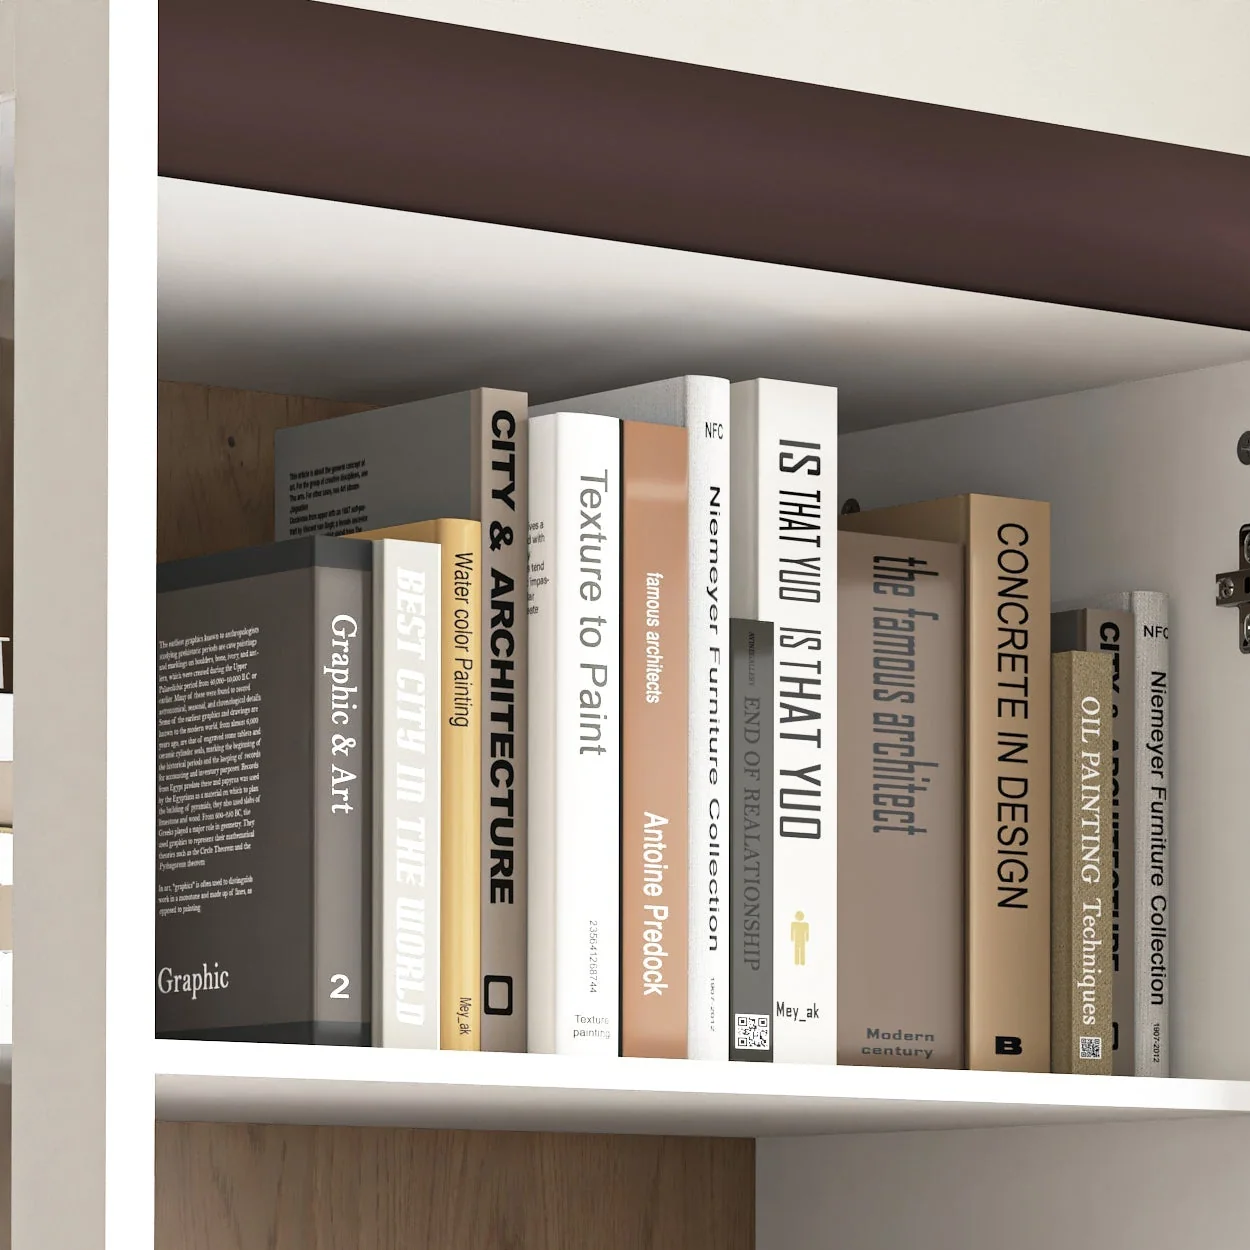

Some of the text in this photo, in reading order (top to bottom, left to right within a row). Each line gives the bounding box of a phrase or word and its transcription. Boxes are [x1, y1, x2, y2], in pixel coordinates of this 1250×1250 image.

[705, 421, 724, 440] NFC
[448, 552, 474, 728] Water color Painting
[489, 409, 517, 905] CITY & ARCHITECTURE
[579, 468, 609, 756] Texture to Paint
[645, 572, 664, 704] famous architects
[778, 438, 822, 841] IS THAT YUO IS THAT YUO
[872, 555, 940, 836] the famous architect
[327, 614, 358, 815] Graphic & Art
[396, 566, 426, 1026] BEST CITY IN THE WORLD
[705, 485, 722, 951] Niemeyer Furniture Collection
[996, 522, 1030, 909] CONCRETE IN DESIGN
[642, 811, 670, 996] Antoine Predock
[743, 695, 761, 971] END OF REALATIONSHIP
[1076, 695, 1103, 1026] OIL PAINTING Techniques
[1146, 670, 1168, 1006] Niemeyer Furniture Collection
[157, 961, 230, 1001] Graphic
[329, 973, 350, 999] 2
[455, 997, 472, 1035] Mey_ak
[573, 1029, 610, 1040] painting
[574, 1014, 609, 1025] Texture
[776, 1000, 820, 1023] Mey_ak
[861, 1045, 933, 1060] century
[866, 1027, 935, 1042] Modern
[994, 1035, 1023, 1056] B
[1152, 1023, 1161, 1063] 1907-2012
